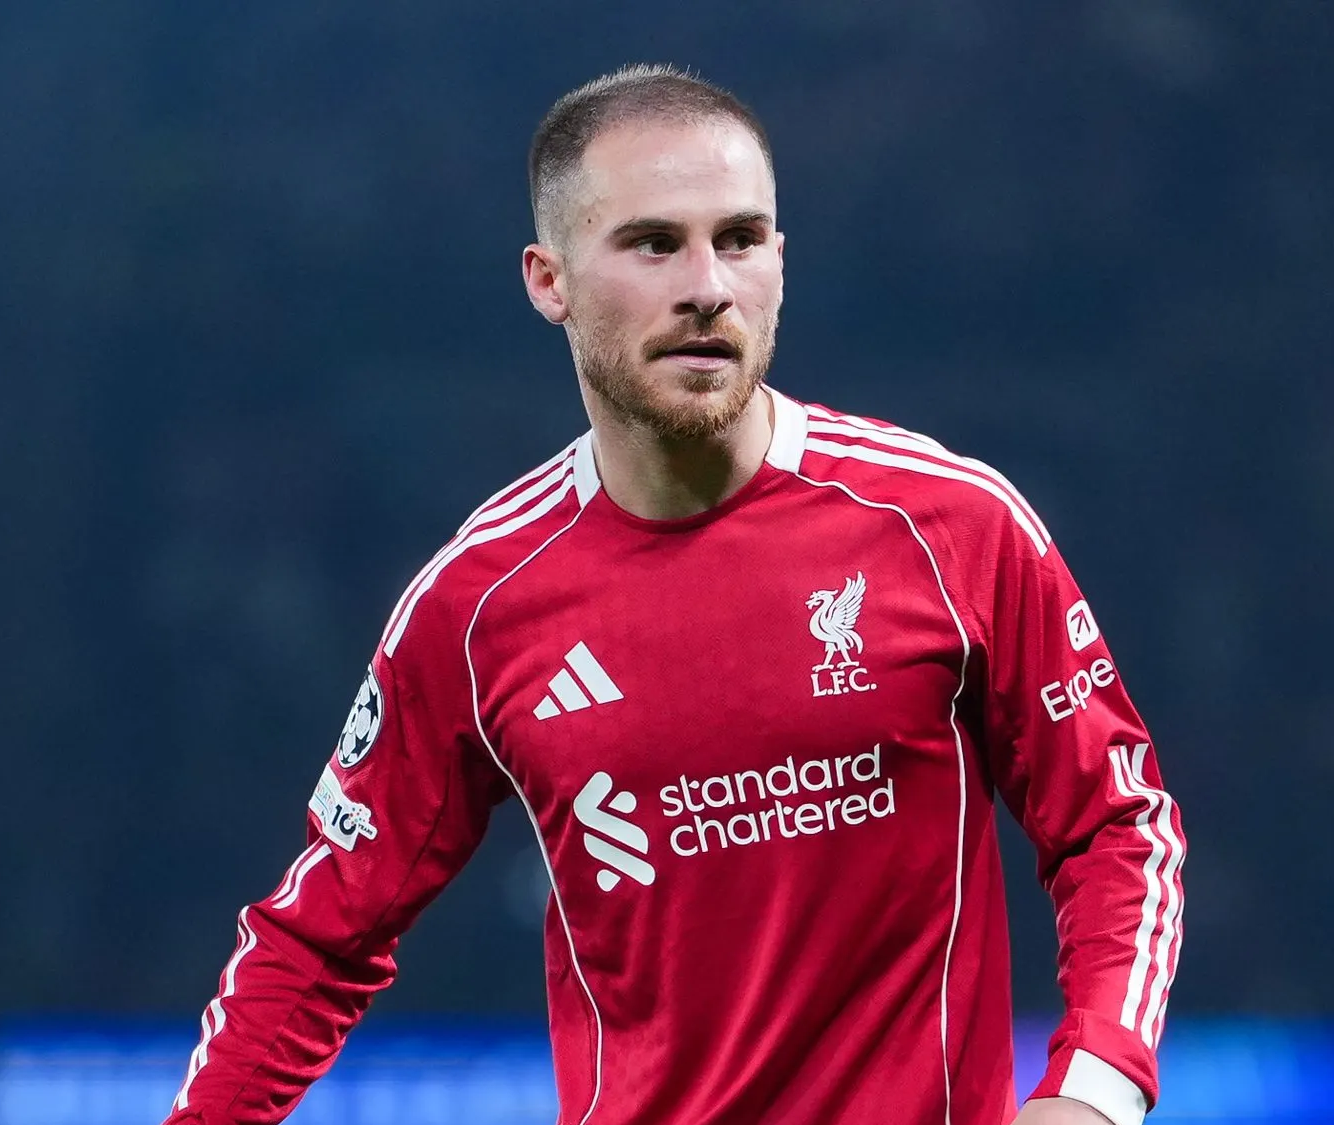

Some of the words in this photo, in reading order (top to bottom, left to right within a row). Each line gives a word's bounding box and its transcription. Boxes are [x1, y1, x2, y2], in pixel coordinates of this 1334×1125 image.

[811, 667, 877, 697] L.F.C.
[660, 743, 881, 817] standard
[331, 804, 357, 836] 10
[669, 778, 896, 857] chartered
